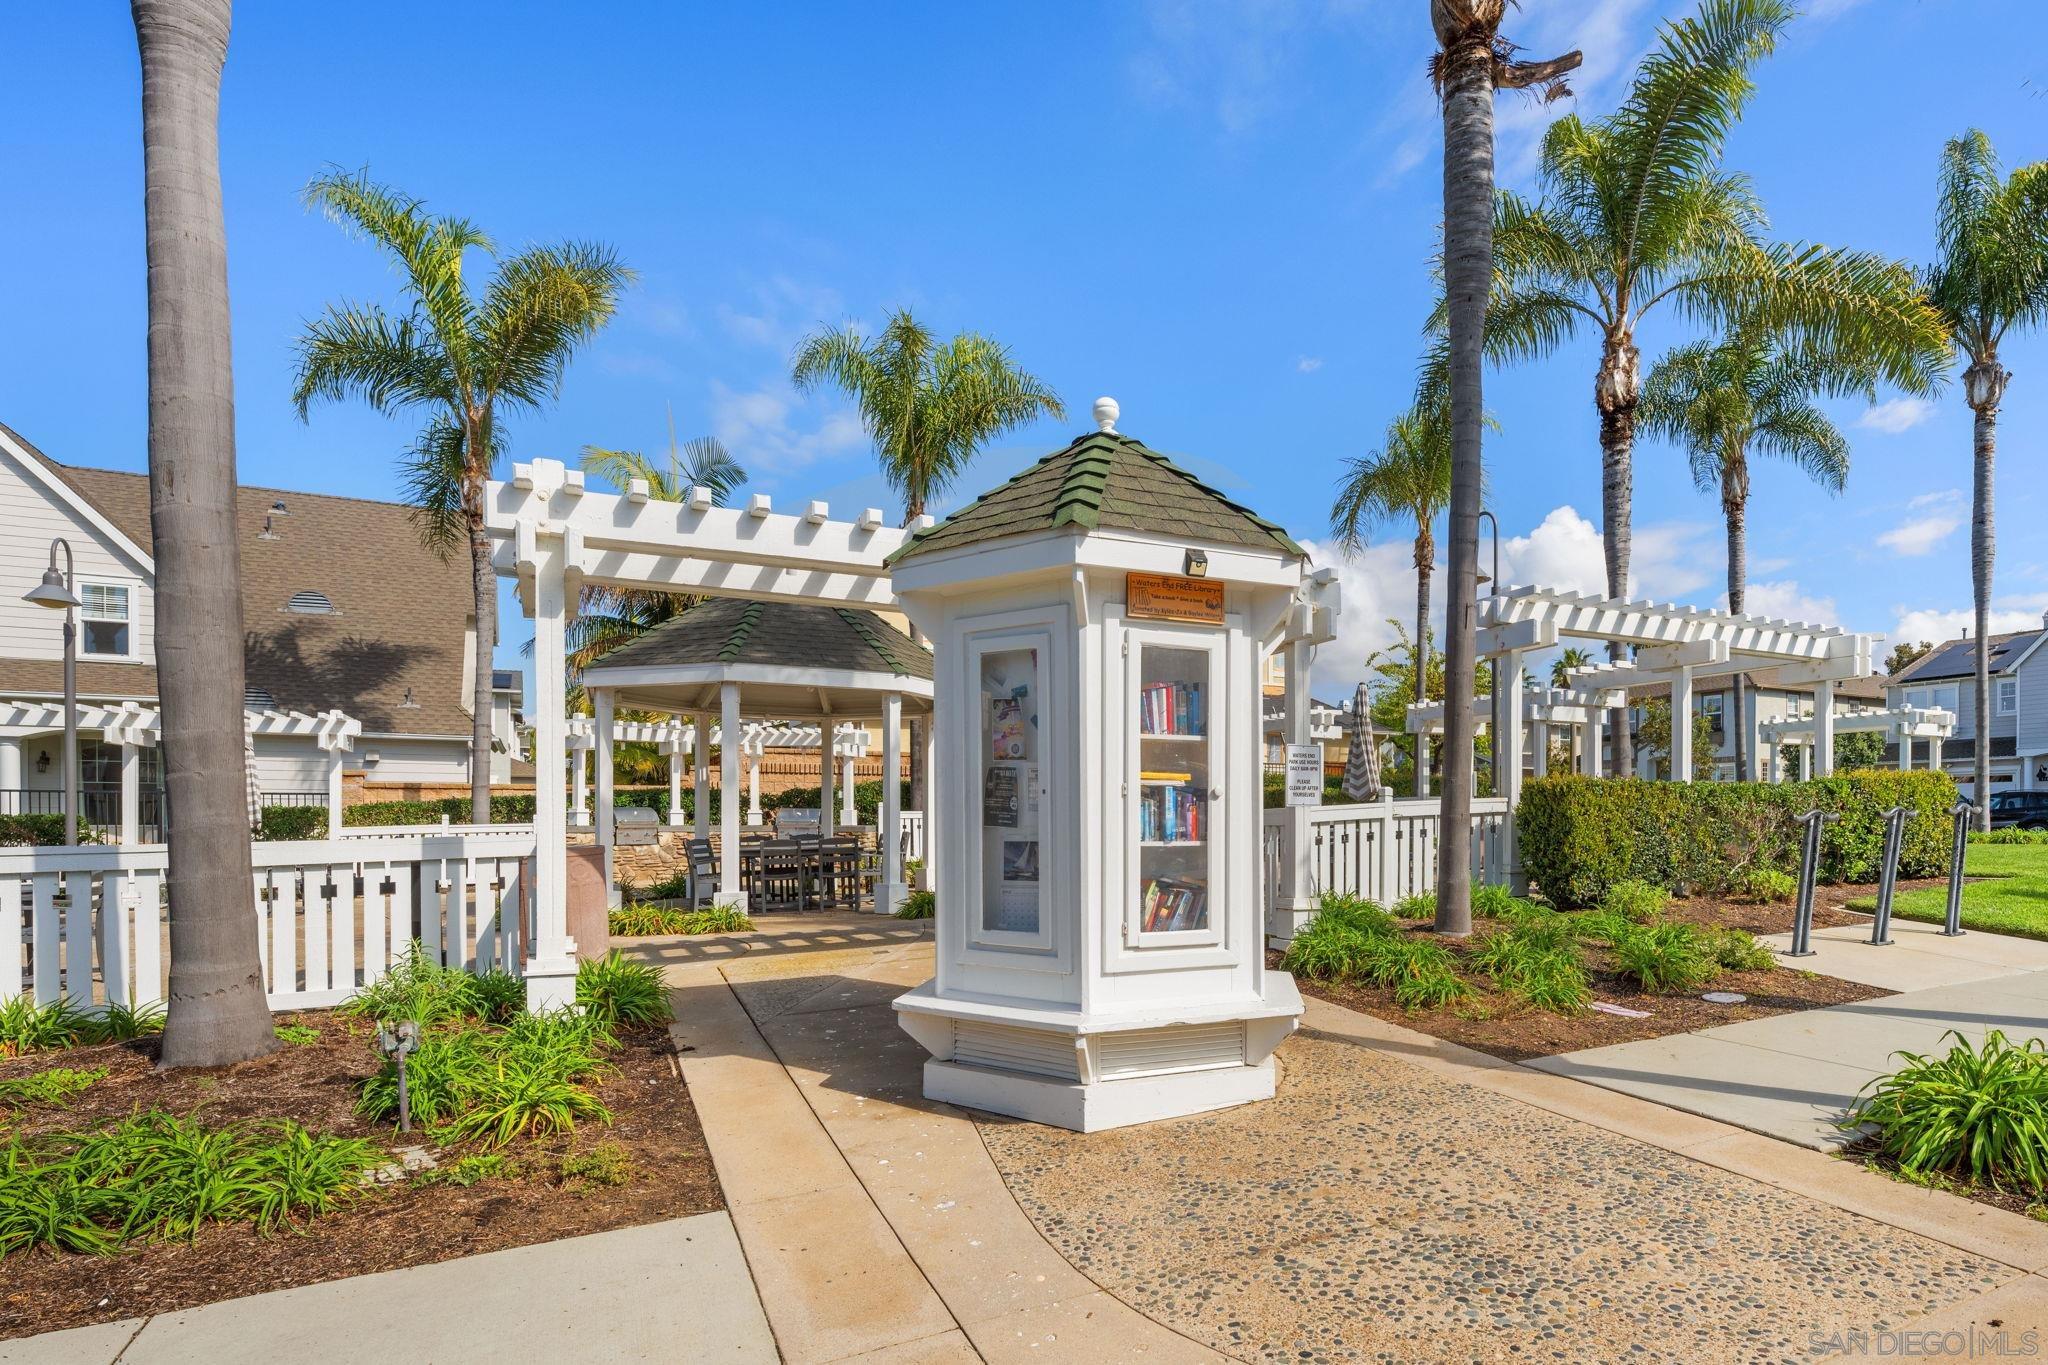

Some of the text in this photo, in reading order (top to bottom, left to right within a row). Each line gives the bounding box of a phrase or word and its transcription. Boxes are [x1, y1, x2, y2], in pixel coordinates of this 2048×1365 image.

[1136, 578, 1217, 595] Waters End FREE Library
